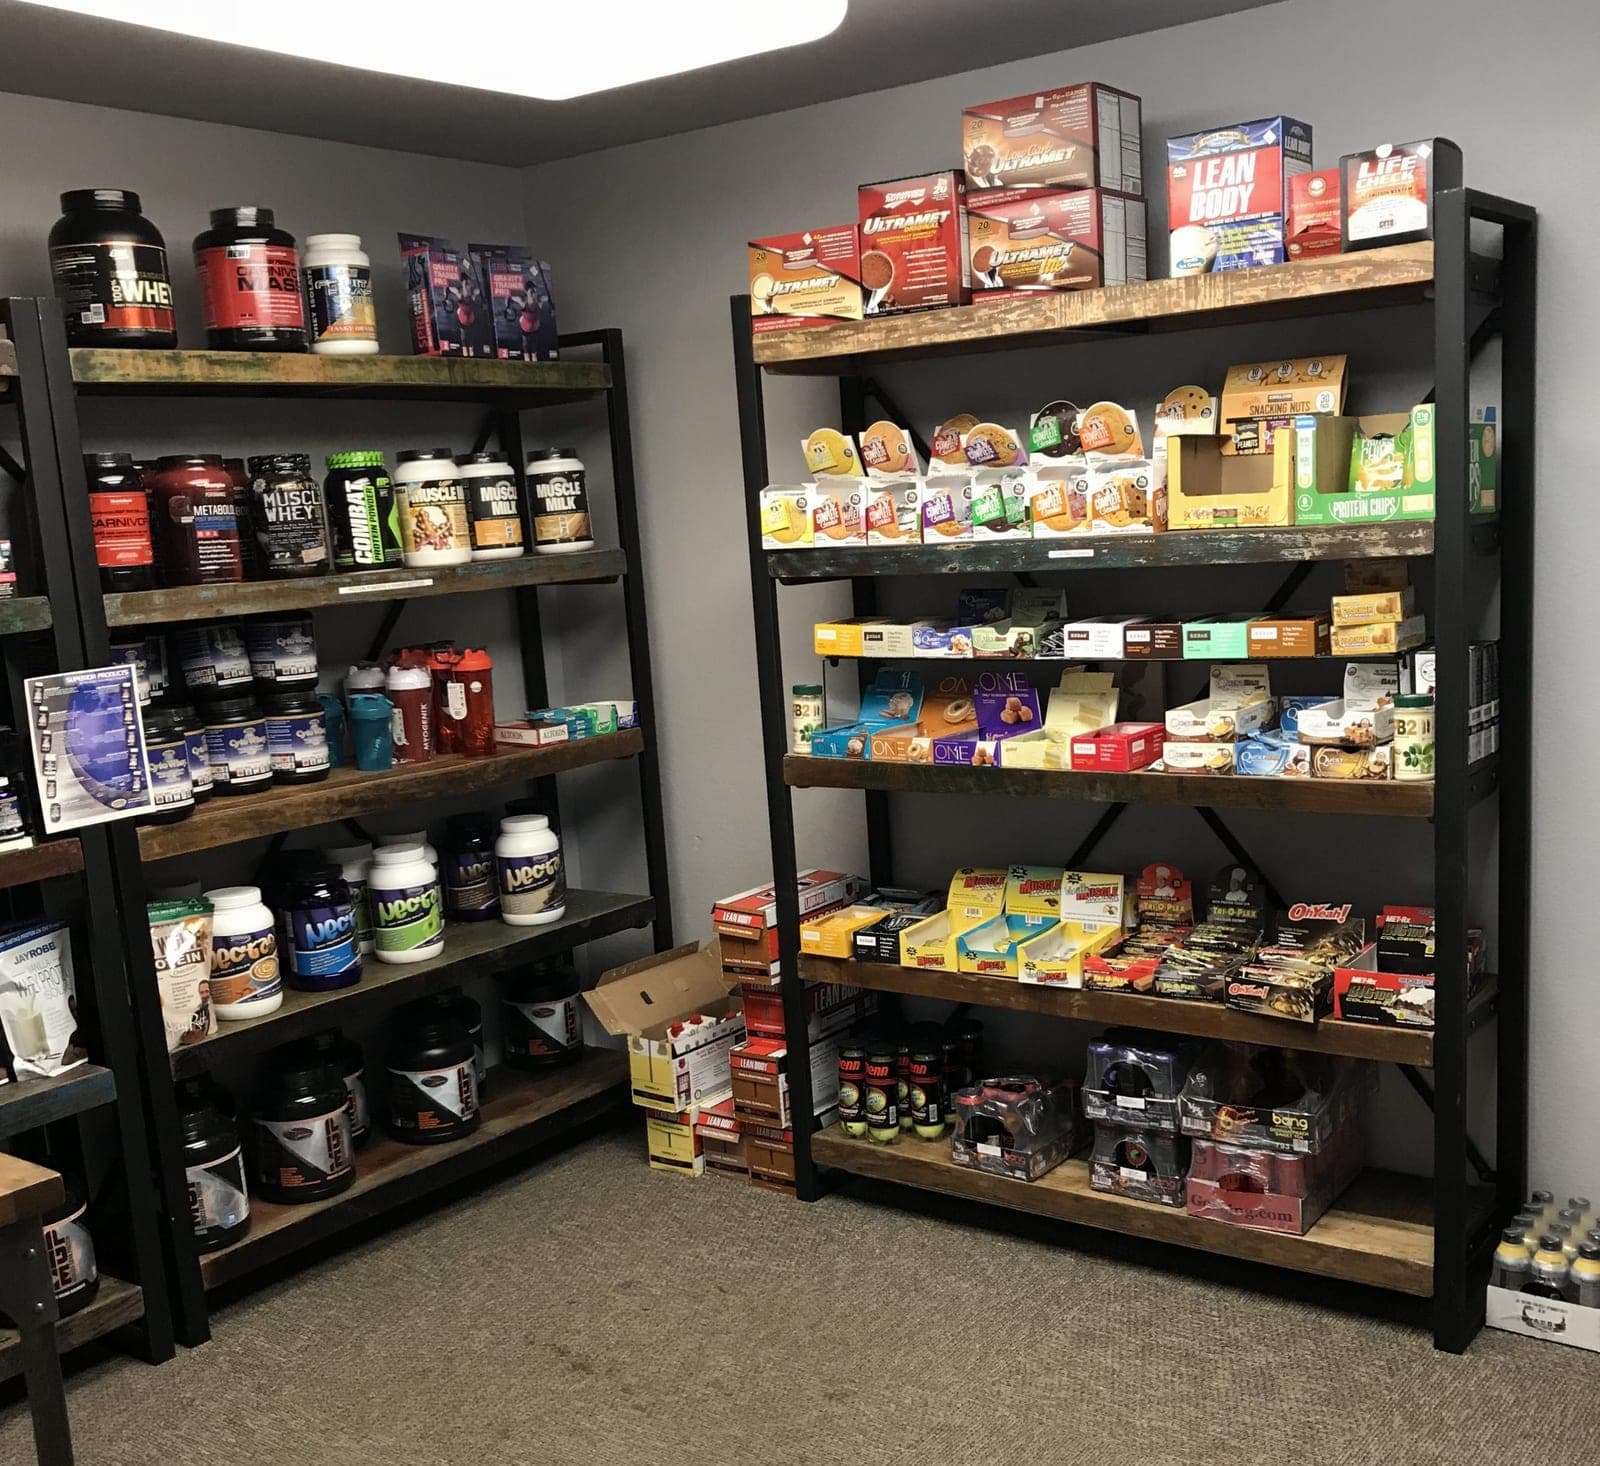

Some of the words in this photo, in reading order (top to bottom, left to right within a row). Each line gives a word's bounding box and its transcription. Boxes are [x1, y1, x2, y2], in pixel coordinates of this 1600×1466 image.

[990, 147, 1076, 174] ULTRAMET
[1358, 154, 1418, 180] LIFE
[1193, 152, 1256, 192] LEAN
[1355, 170, 1415, 192] CHECK
[1189, 184, 1255, 223] BODY
[863, 210, 951, 235] ULTRAMET
[977, 221, 989, 230] 20
[990, 242, 1075, 266] ULTRAMET
[120, 279, 173, 306] WHEY
[766, 275, 841, 297] ULTRAMET
[1249, 402, 1287, 416] SNACKING
[1290, 400, 1311, 413] NUTS
[1237, 438, 1259, 449] PEANUTS
[263, 490, 322, 507] MUSCL
[535, 482, 581, 498] MUSCLE
[264, 505, 315, 523] WHEY
[365, 487, 377, 524] POWDER
[546, 497, 577, 512] MILK
[1332, 500, 1369, 520] PROTEIN
[1370, 496, 1397, 516] CHIPS
[344, 476, 374, 564] COMBAT
[370, 524, 383, 562] PROTEIN
[978, 672, 1028, 692] ONE
[423, 703, 431, 751] MYOGENIX
[500, 728, 524, 740] ALTOIDS
[542, 726, 567, 739] ALTOIDS
[872, 740, 906, 757] ONE
[934, 743, 970, 761] ONE
[722, 911, 737, 922] LEAN
[1288, 903, 1352, 924] OhYeah!
[304, 907, 357, 950] Nect
[13, 941, 57, 966] JAYROBB
[740, 1058, 753, 1068] LEAN
[753, 1061, 768, 1072] BODY
[838, 1057, 861, 1072] enn
[865, 1061, 889, 1077] enn
[706, 1116, 720, 1127] LEAN
[720, 1118, 735, 1129] BODY
[1271, 1111, 1309, 1131] bang
[756, 1126, 770, 1138] LEAN
